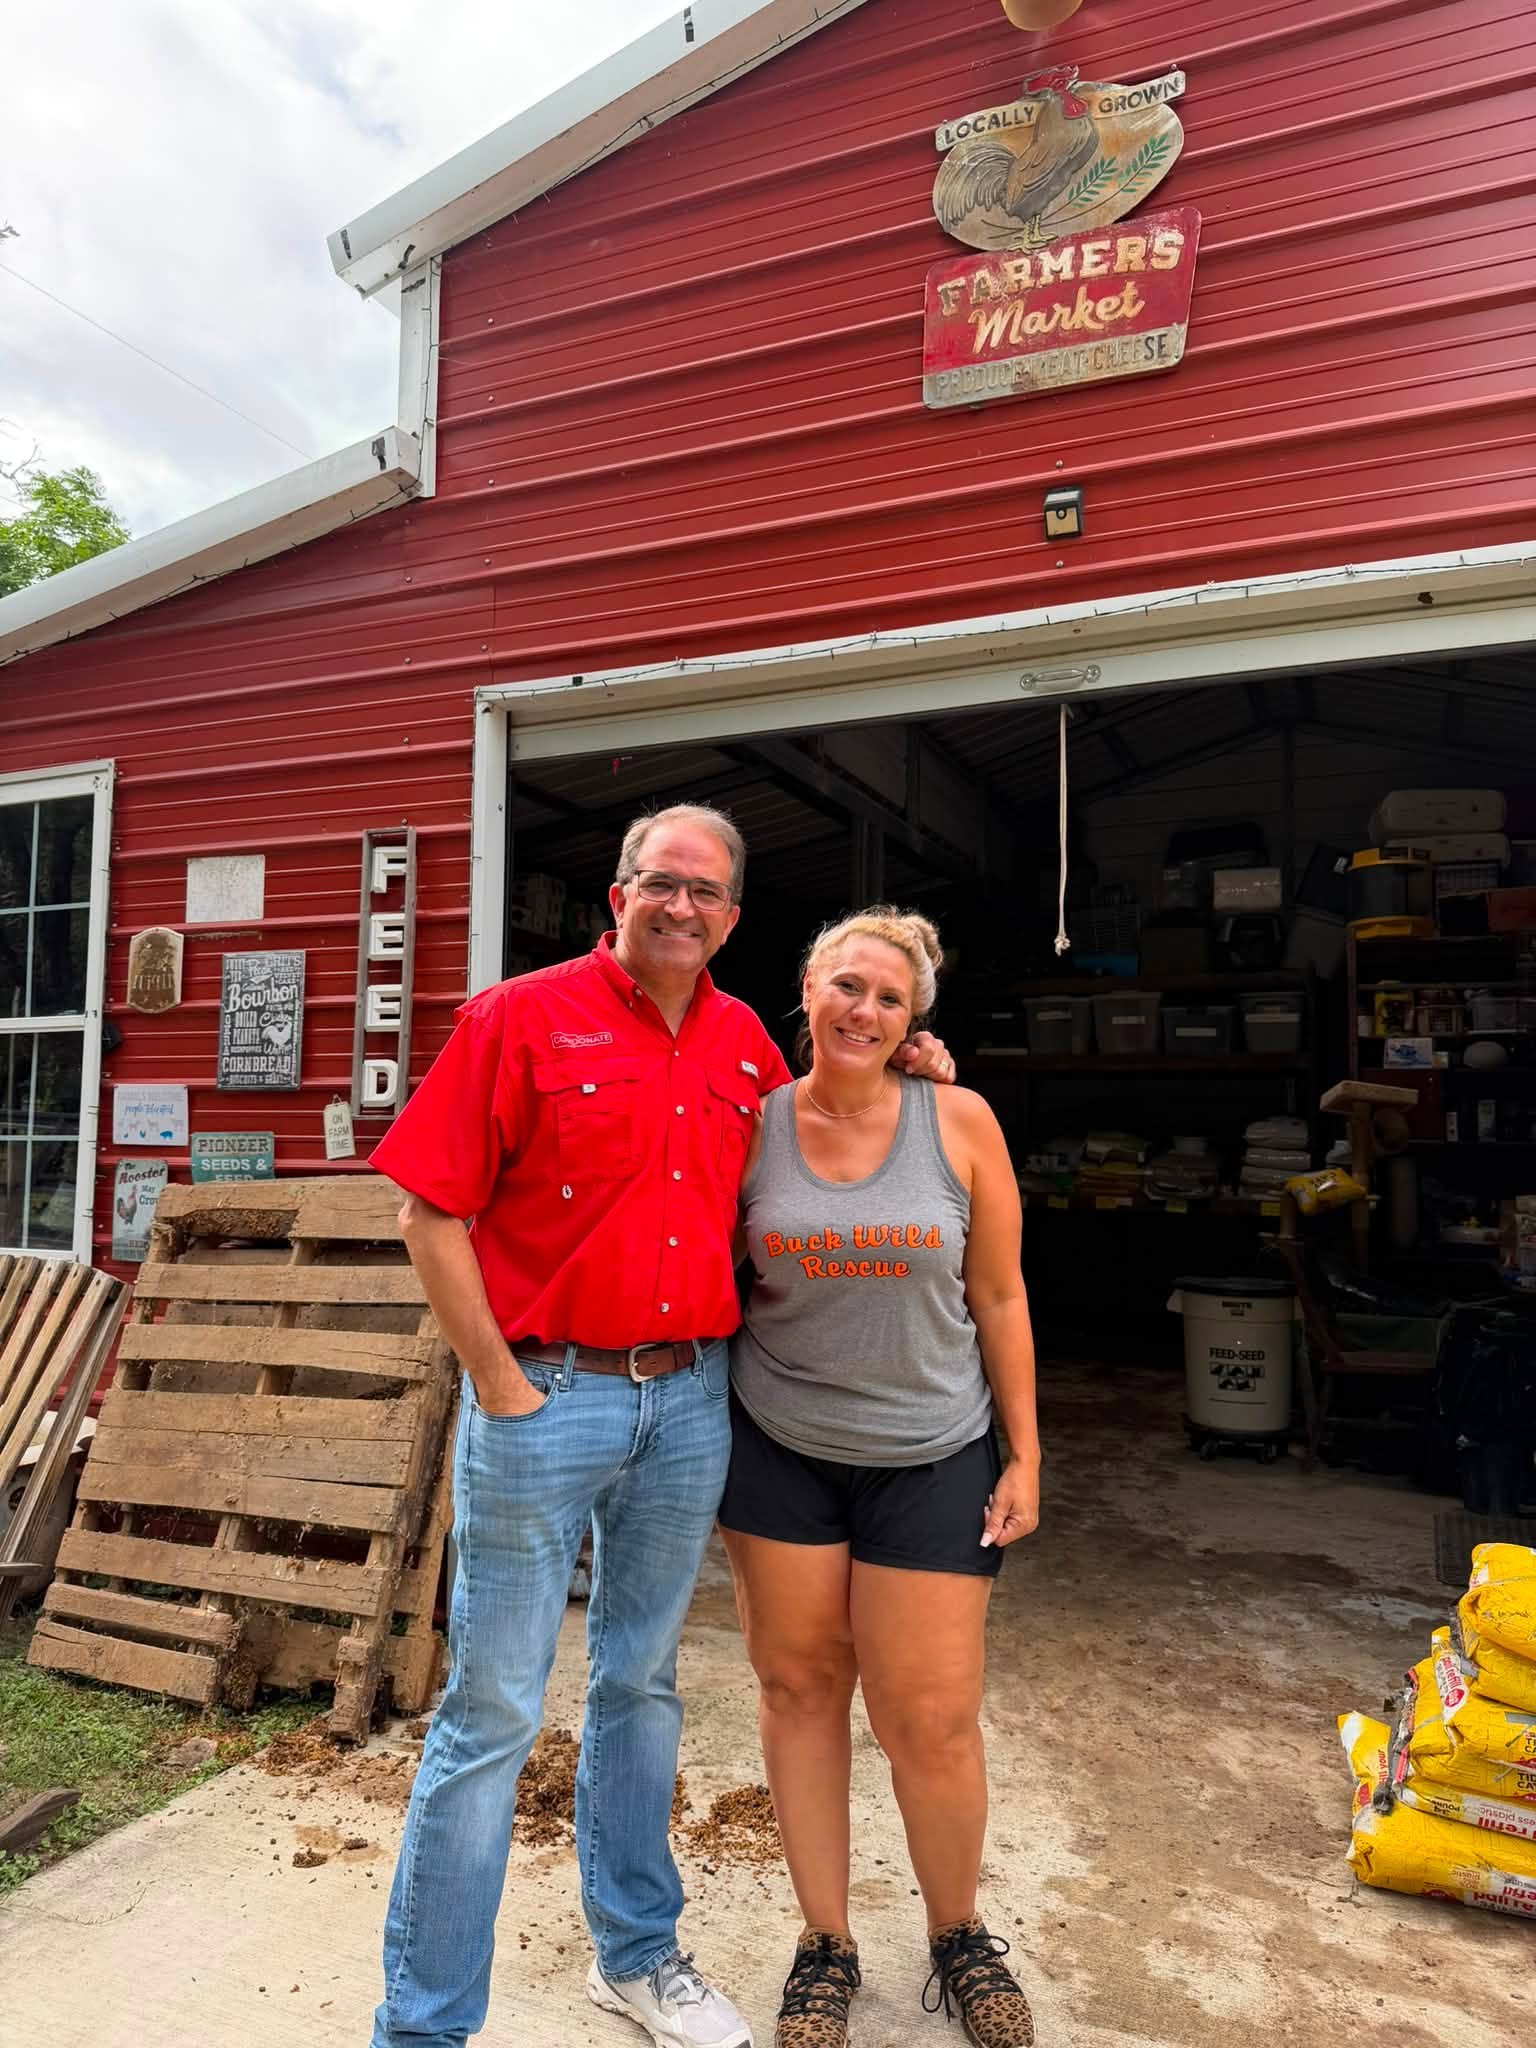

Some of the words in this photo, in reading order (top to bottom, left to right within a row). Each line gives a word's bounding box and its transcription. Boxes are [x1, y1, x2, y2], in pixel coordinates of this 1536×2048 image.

[944, 104, 1035, 145] LOCALLY
[1098, 76, 1181, 114] GROWN
[937, 231, 1185, 317] FARMERS
[968, 281, 1145, 354] Market
[1092, 332, 1169, 371] CHEESE
[363, 846, 407, 1108] FEED
[224, 977, 298, 1013] Bourbon
[222, 1056, 292, 1073] CORNBREAD
[332, 1112, 344, 1125] ON
[328, 1125, 349, 1137] FARM
[198, 1138, 269, 1153] PIONEER
[330, 1139, 350, 1151] TIME
[119, 1165, 166, 1184] Rooster
[201, 1158, 250, 1171] SEEDS
[255, 1158, 268, 1171] &
[762, 1226, 846, 1258] Buck
[853, 1223, 944, 1249] Wild
[800, 1255, 911, 1280] Rescue
[1209, 1347, 1265, 1361] FEED-SEED
[1479, 1816, 1528, 1836] refill
